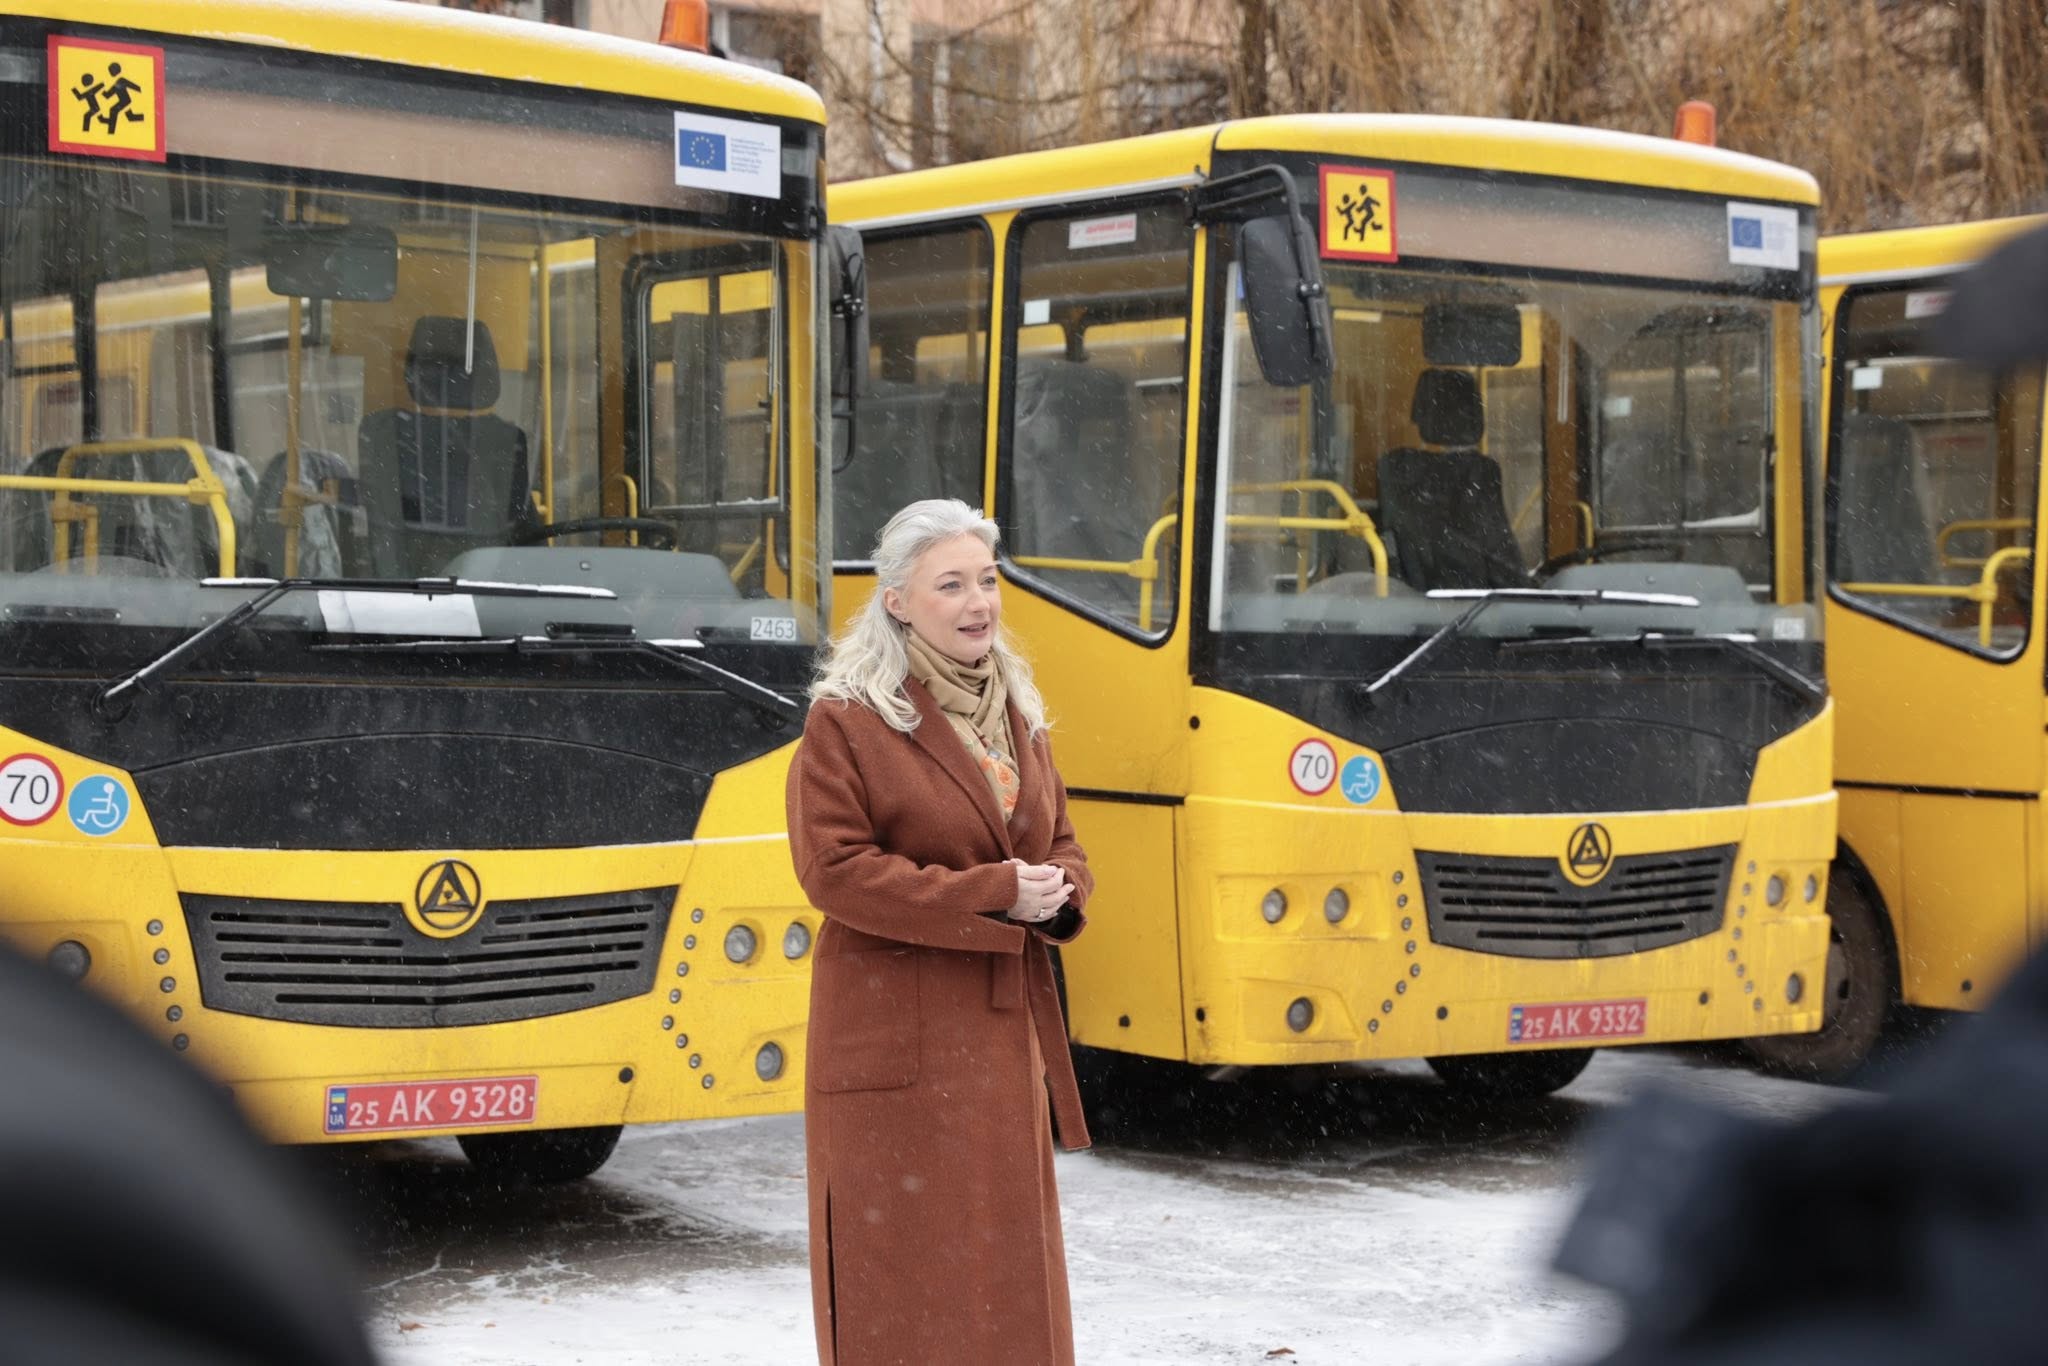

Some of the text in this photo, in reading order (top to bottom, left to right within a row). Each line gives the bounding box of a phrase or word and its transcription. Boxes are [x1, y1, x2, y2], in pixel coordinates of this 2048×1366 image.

[752, 618, 794, 639] 2463
[1300, 754, 1329, 779] 70
[6, 774, 50, 805] 70
[1522, 1005, 1641, 1038] 25 AK 9332
[349, 1084, 526, 1126] 25 AK 9328
[329, 1113, 345, 1126] UA
